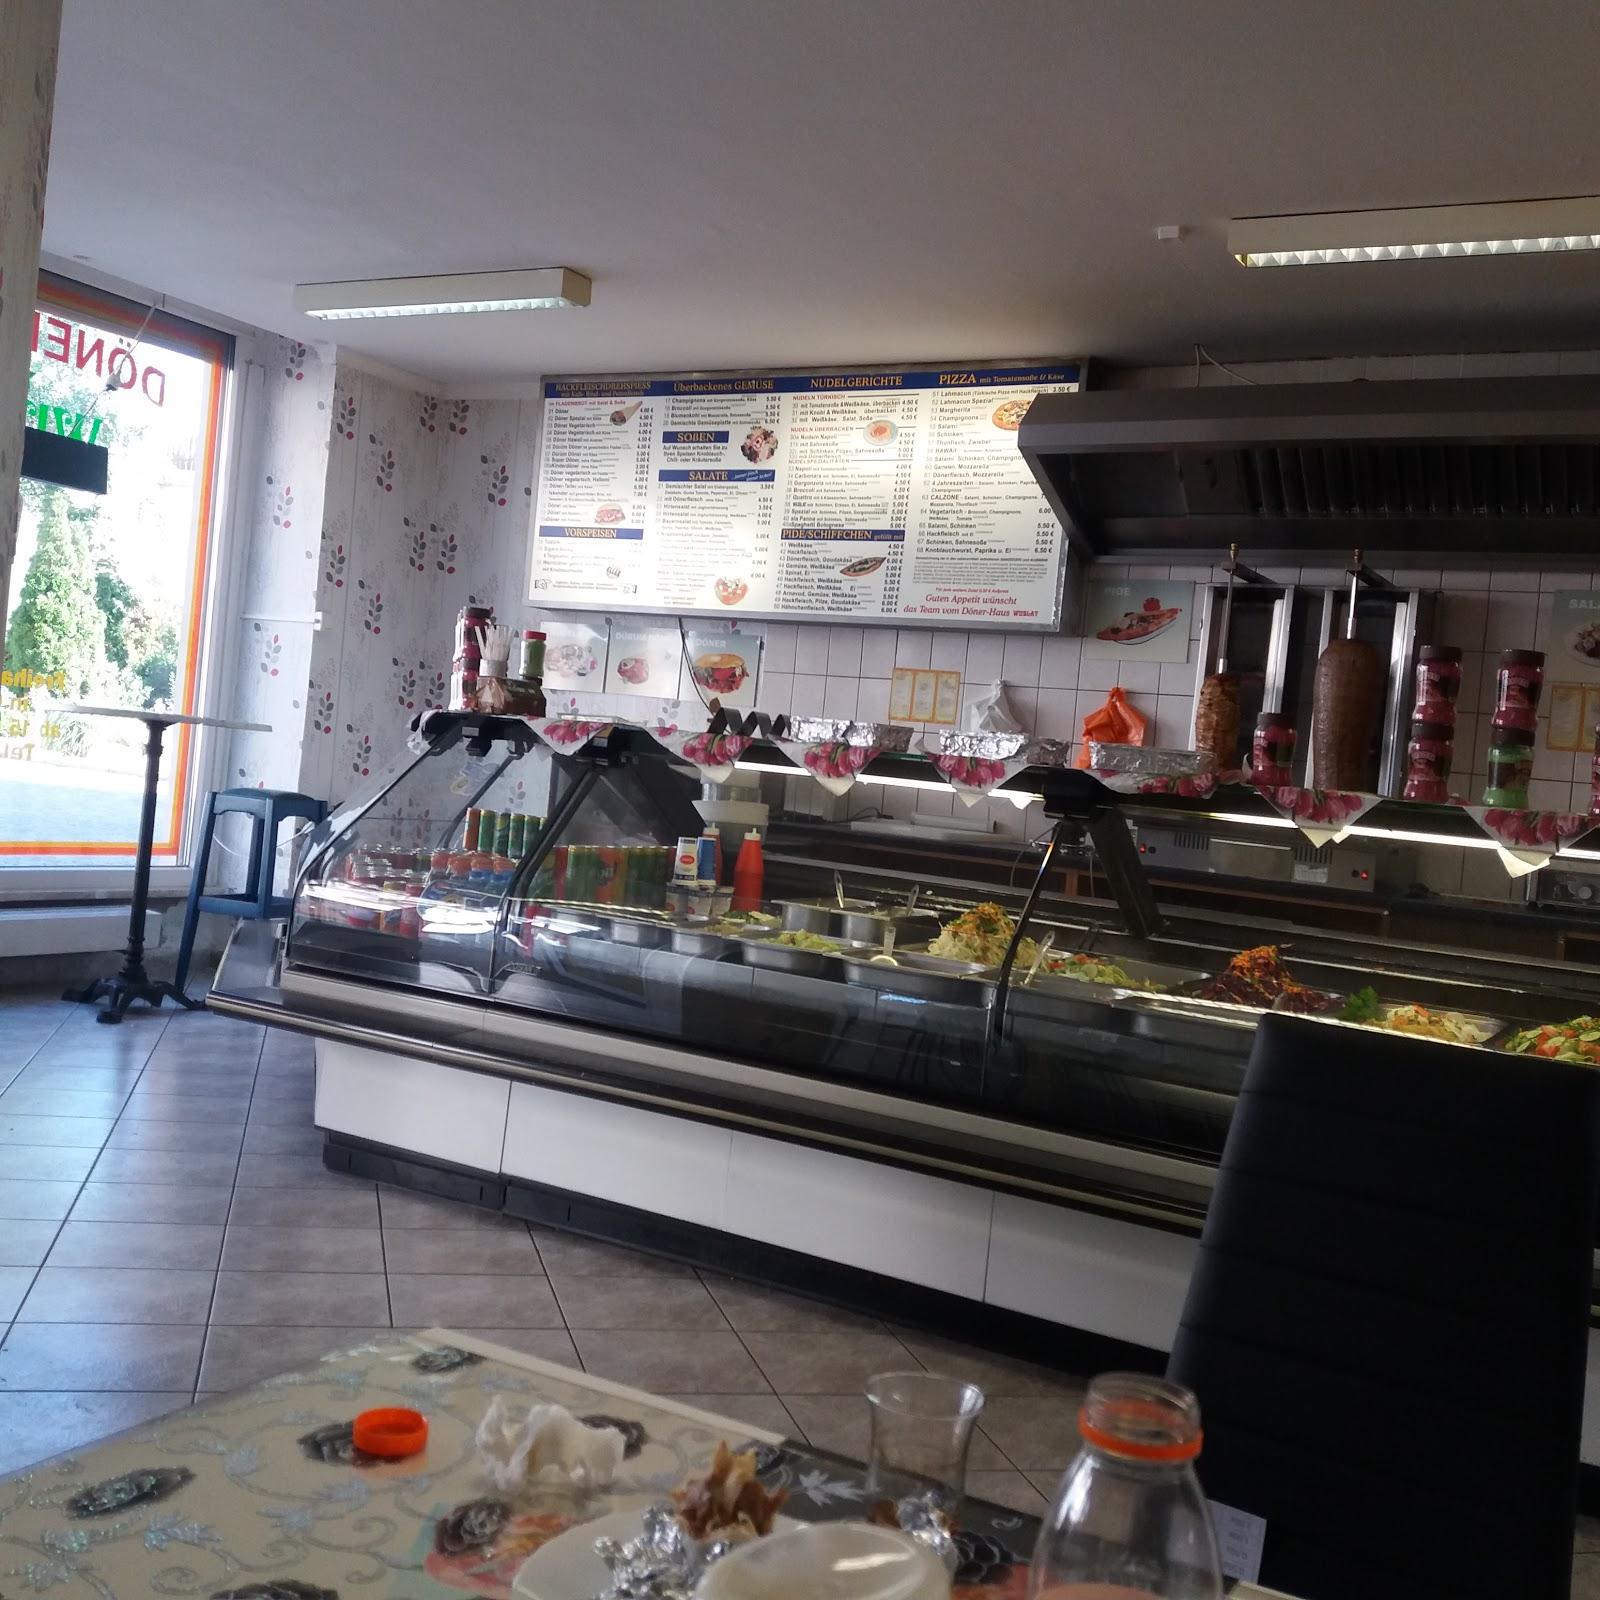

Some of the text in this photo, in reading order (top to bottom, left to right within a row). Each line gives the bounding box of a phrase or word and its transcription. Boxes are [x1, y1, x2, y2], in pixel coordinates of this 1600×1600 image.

[673, 378, 774, 391] Überbackenes GEMÜSE
[810, 376, 903, 388] NUDELGERICHTE
[939, 373, 977, 385] PIZZA
[993, 375, 1037, 383] Tomatensoße
[688, 471, 729, 480] SALATE
[564, 527, 617, 537] VORSPEISEN
[782, 530, 872, 540] PIDE/SCHIFFCHEN
[925, 594, 1017, 606] Guten Appetit wünscht
[903, 604, 917, 613] das
[920, 605, 940, 614] Team
[942, 607, 959, 615] vom
[961, 606, 1010, 617] Döner-Haus
[695, 638, 727, 648] DÖNER
